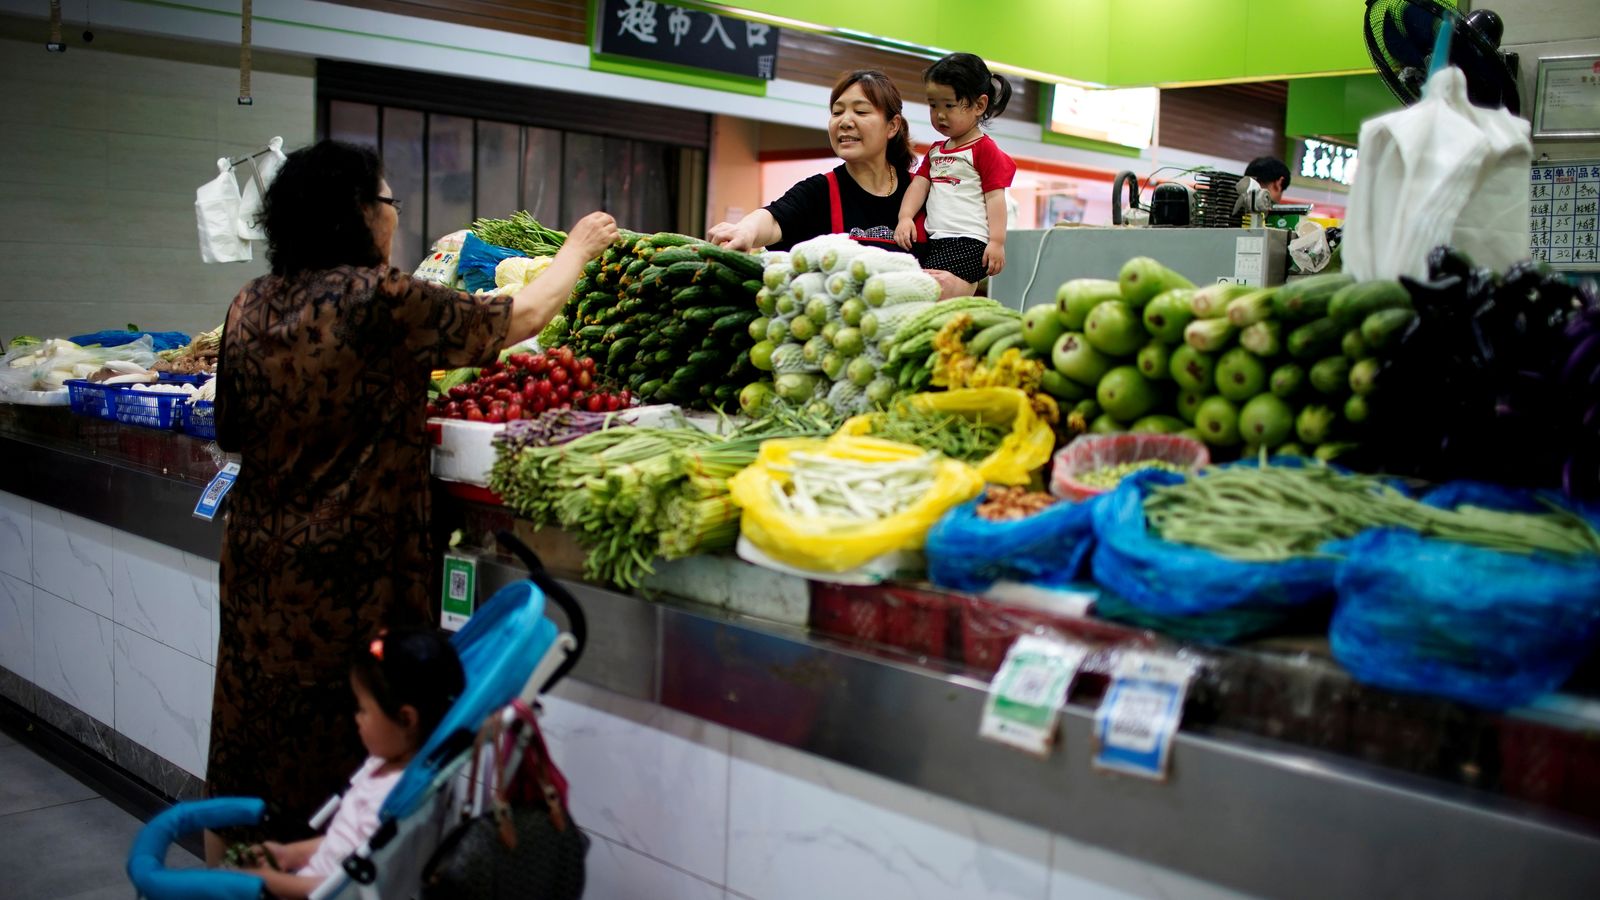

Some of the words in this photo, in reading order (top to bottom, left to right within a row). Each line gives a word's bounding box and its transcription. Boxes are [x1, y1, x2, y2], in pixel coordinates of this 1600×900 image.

[617, 0, 770, 49] 超市入口
[1531, 167, 1552, 180] 品名
[1555, 167, 1576, 177] 单价
[1578, 167, 1600, 178] 品名
[1555, 233, 1569, 244] 2.8
